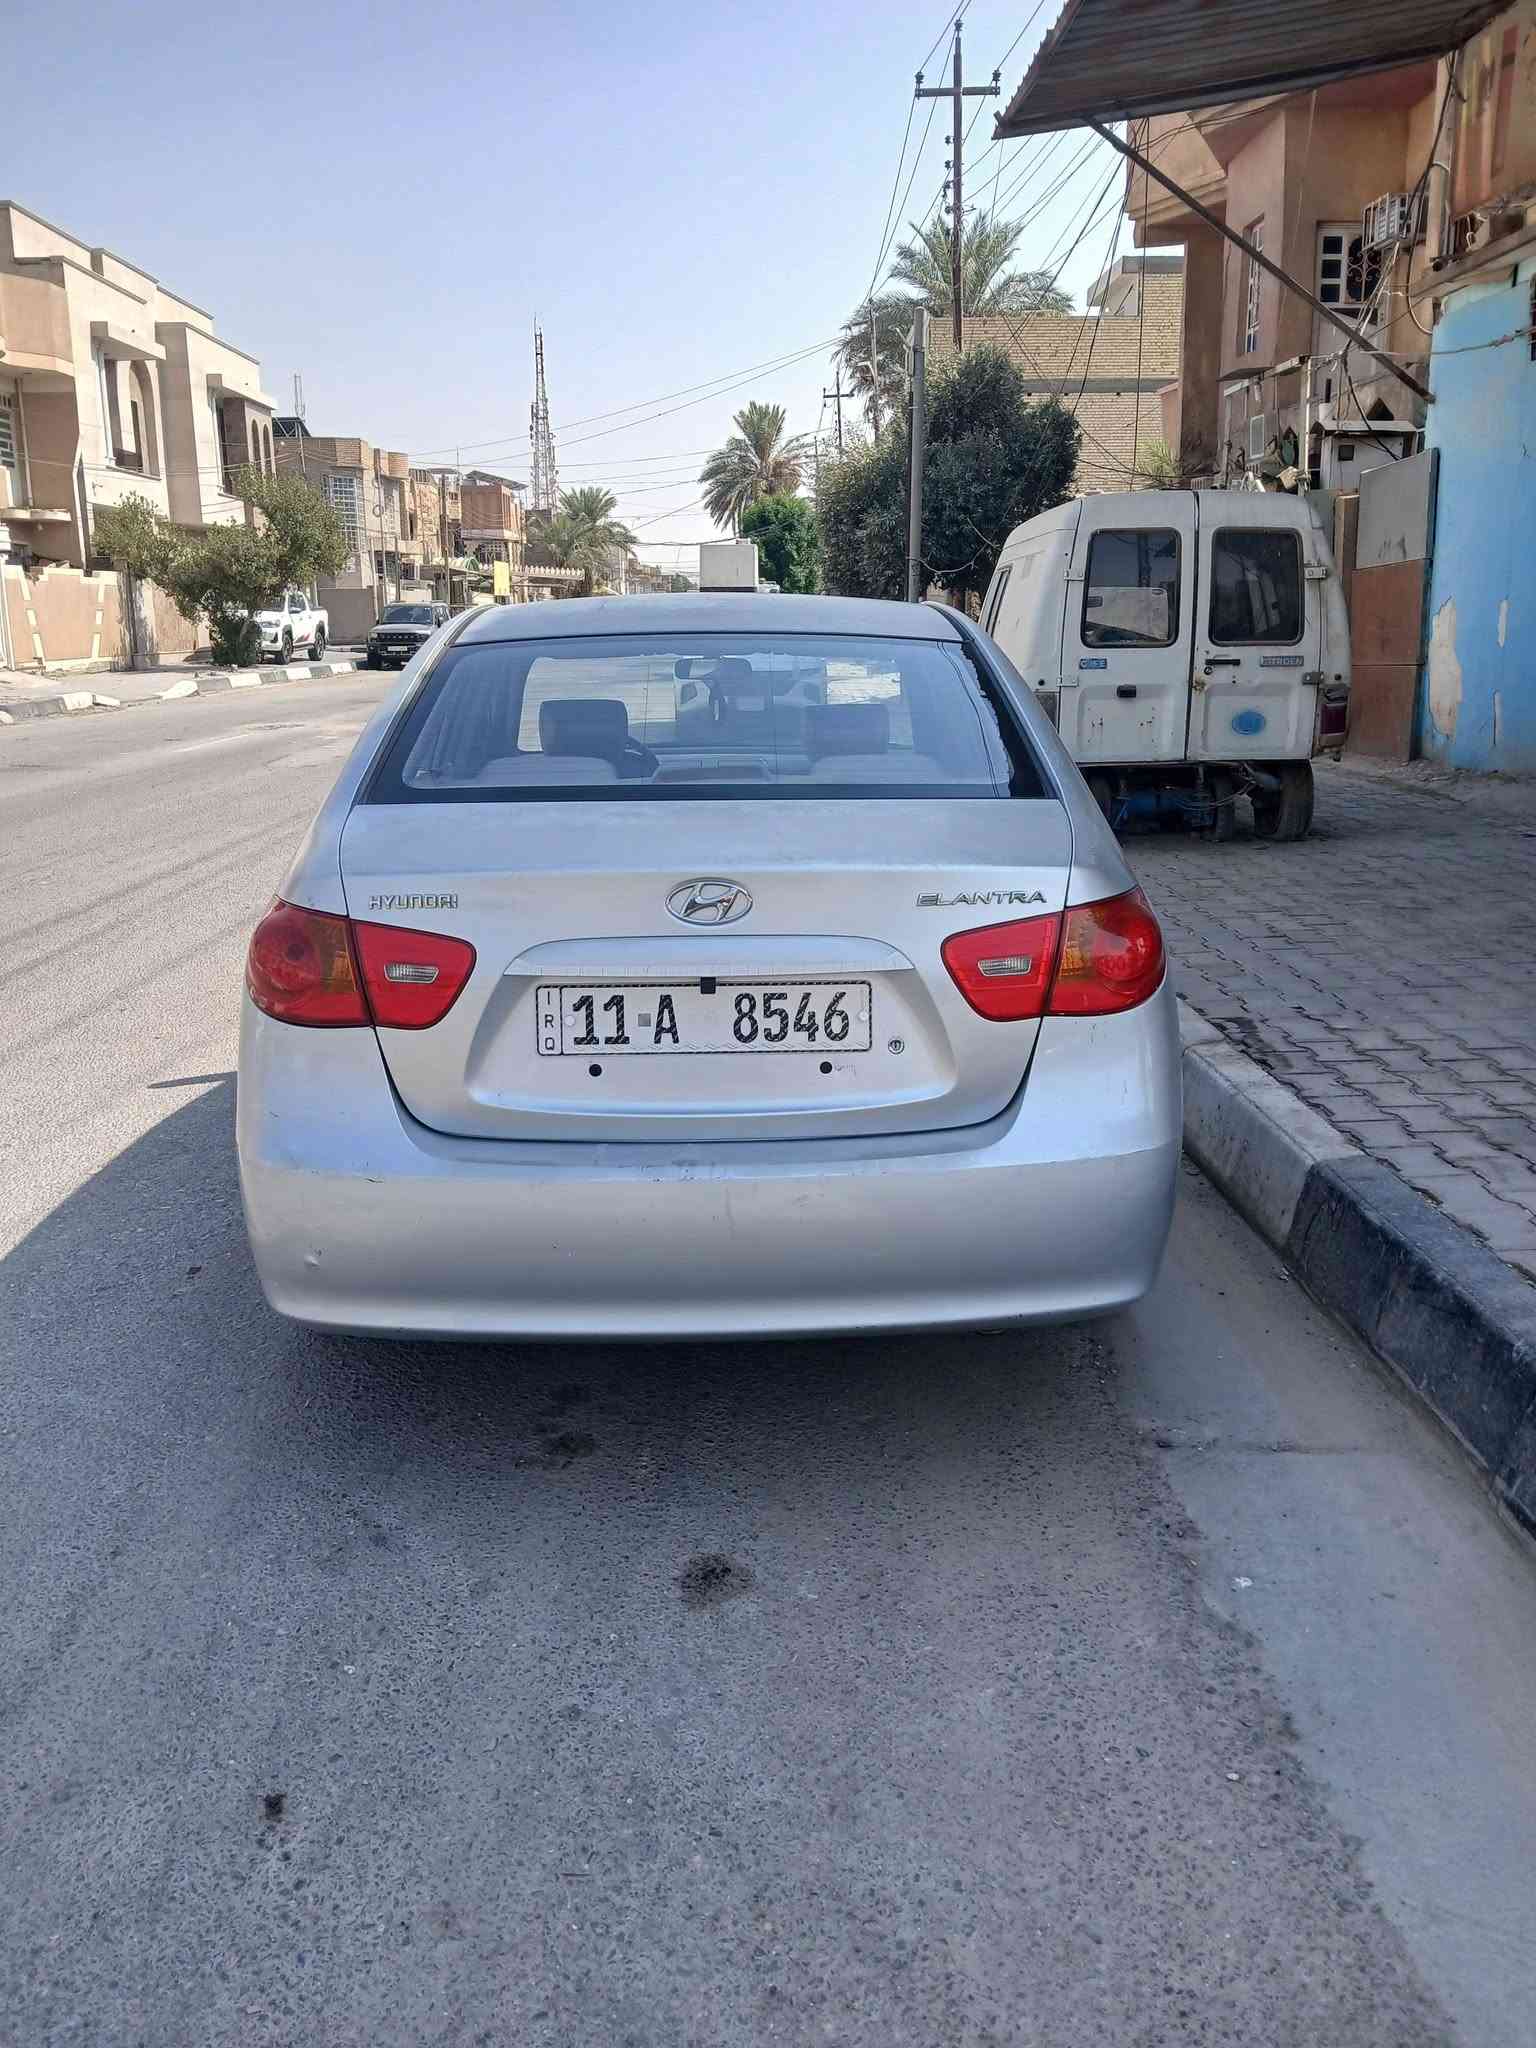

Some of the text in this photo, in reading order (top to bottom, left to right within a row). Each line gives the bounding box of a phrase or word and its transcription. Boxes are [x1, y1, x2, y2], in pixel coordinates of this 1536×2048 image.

[369, 894, 458, 910] HYUNDAI
[916, 890, 1047, 907] ELANTRA
[572, 991, 850, 1045] 11 A 8546
